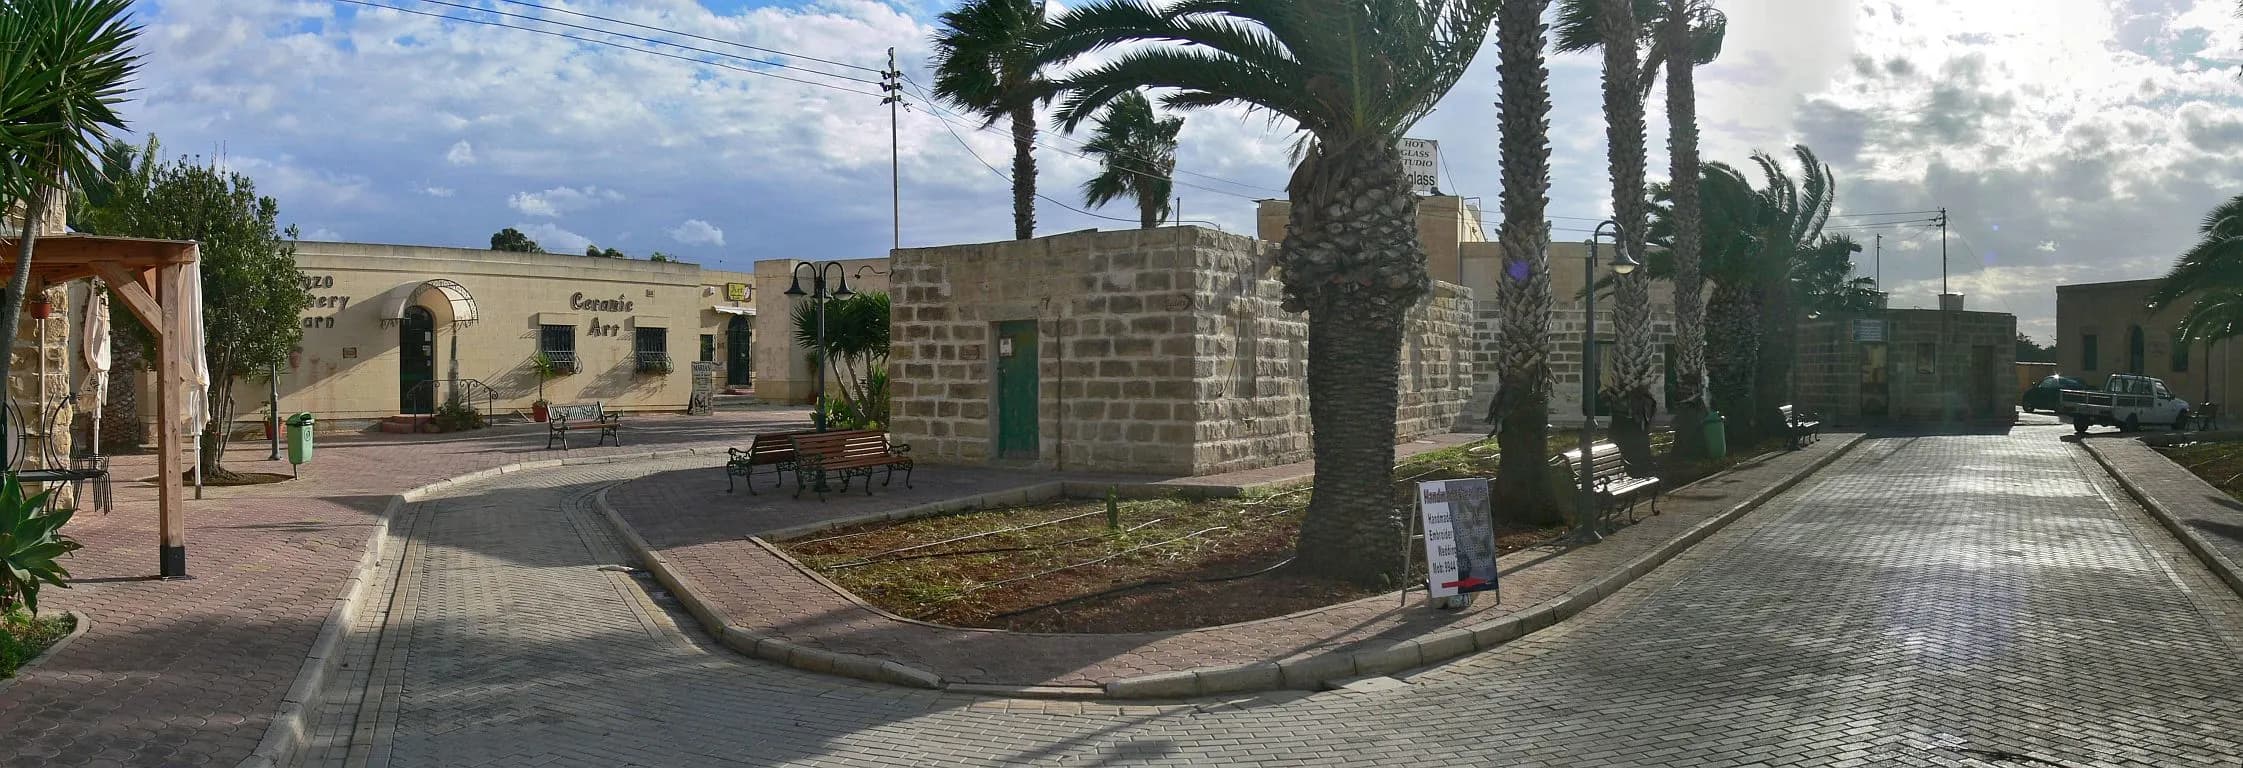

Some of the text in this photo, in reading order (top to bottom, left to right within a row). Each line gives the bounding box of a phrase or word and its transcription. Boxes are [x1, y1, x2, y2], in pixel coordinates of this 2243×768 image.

[1405, 140, 1425, 148] HOT
[1401, 149, 1430, 158] GLASS
[1402, 158, 1433, 167] TUDIO
[302, 275, 334, 290] ozo
[570, 291, 633, 312] Ceramic
[303, 316, 334, 329] arn
[588, 317, 620, 337] Art
